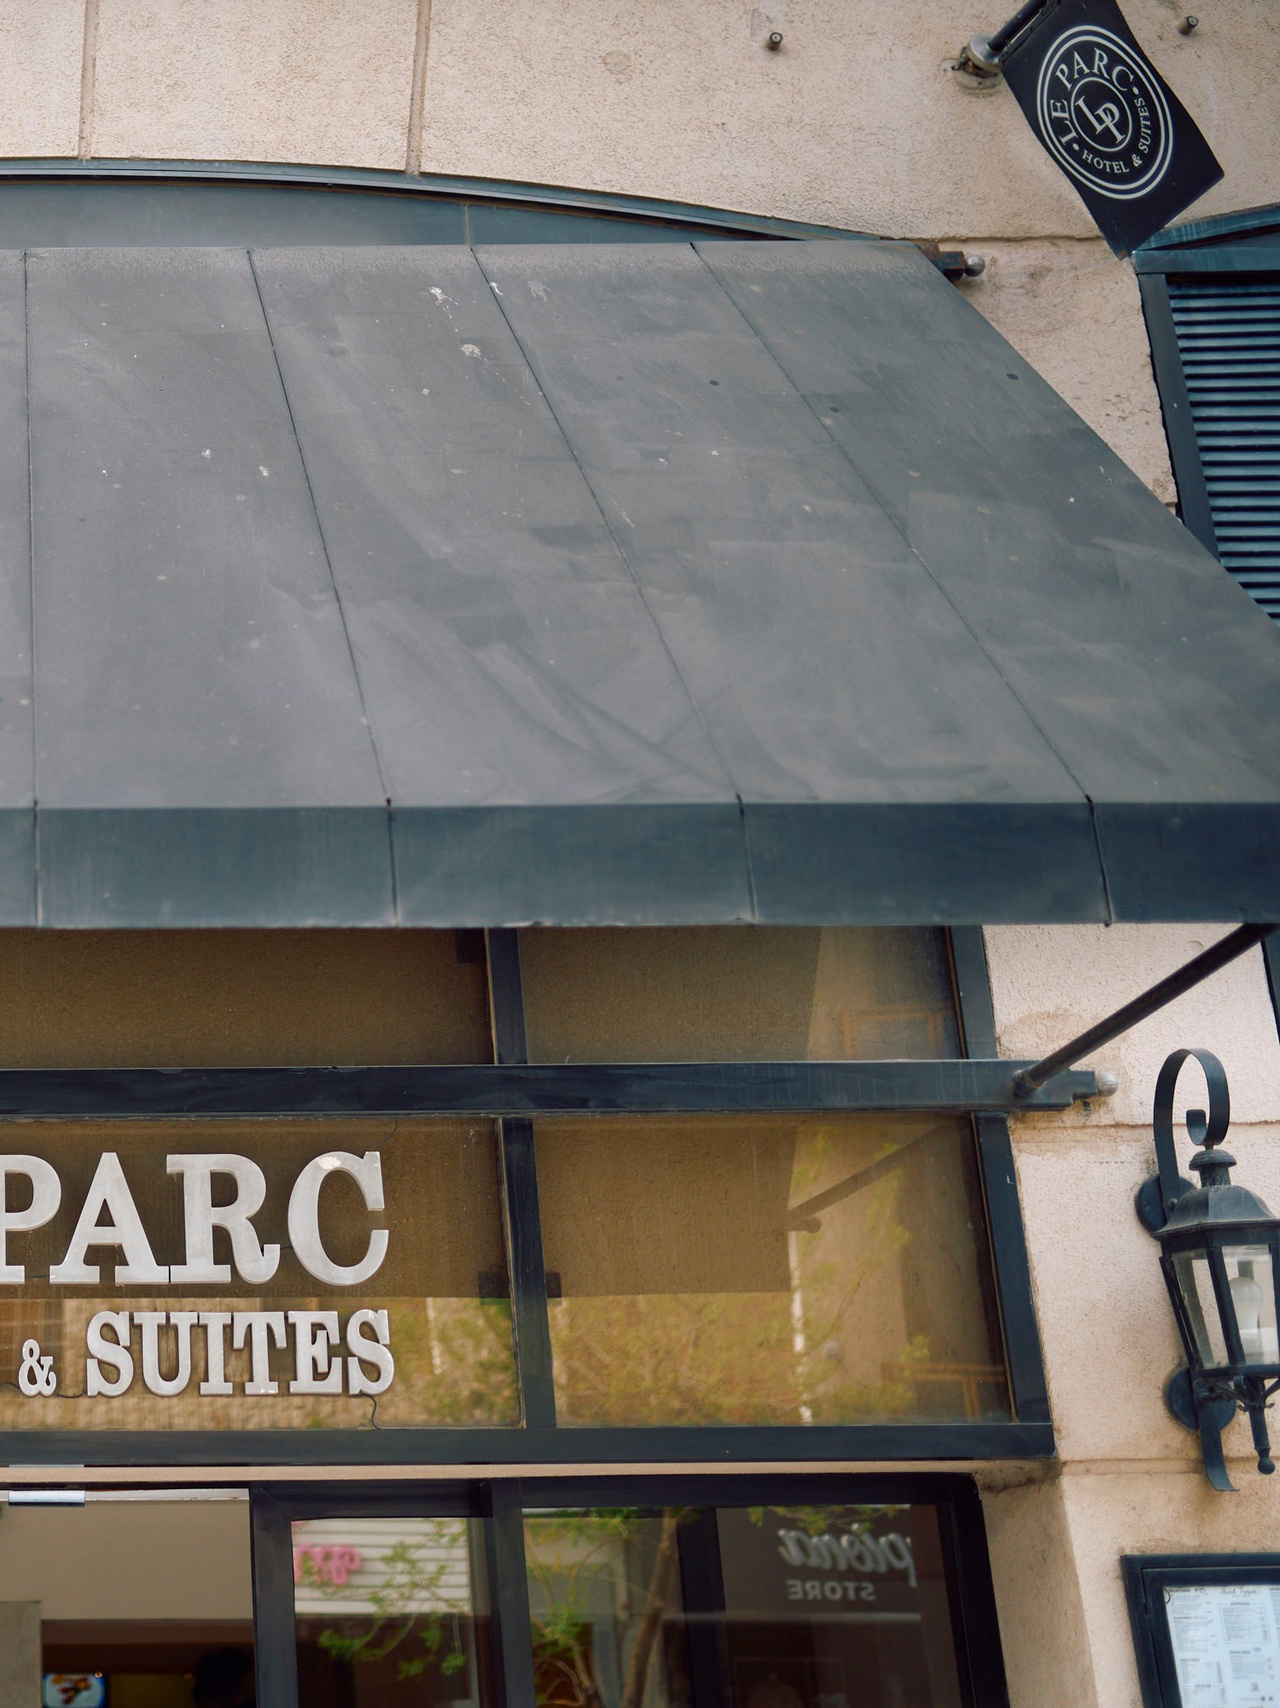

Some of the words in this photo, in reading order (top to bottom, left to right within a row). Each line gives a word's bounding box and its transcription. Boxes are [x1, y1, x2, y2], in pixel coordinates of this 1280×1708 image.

[1055, 47, 1134, 92] PARC
[1050, 98, 1079, 146] LE
[1134, 97, 1153, 154] SUITES
[1082, 149, 1130, 174] HOTEL
[1131, 153, 1143, 168] &
[18, 1338, 57, 1398] &
[86, 1309, 396, 1398] SUITES
